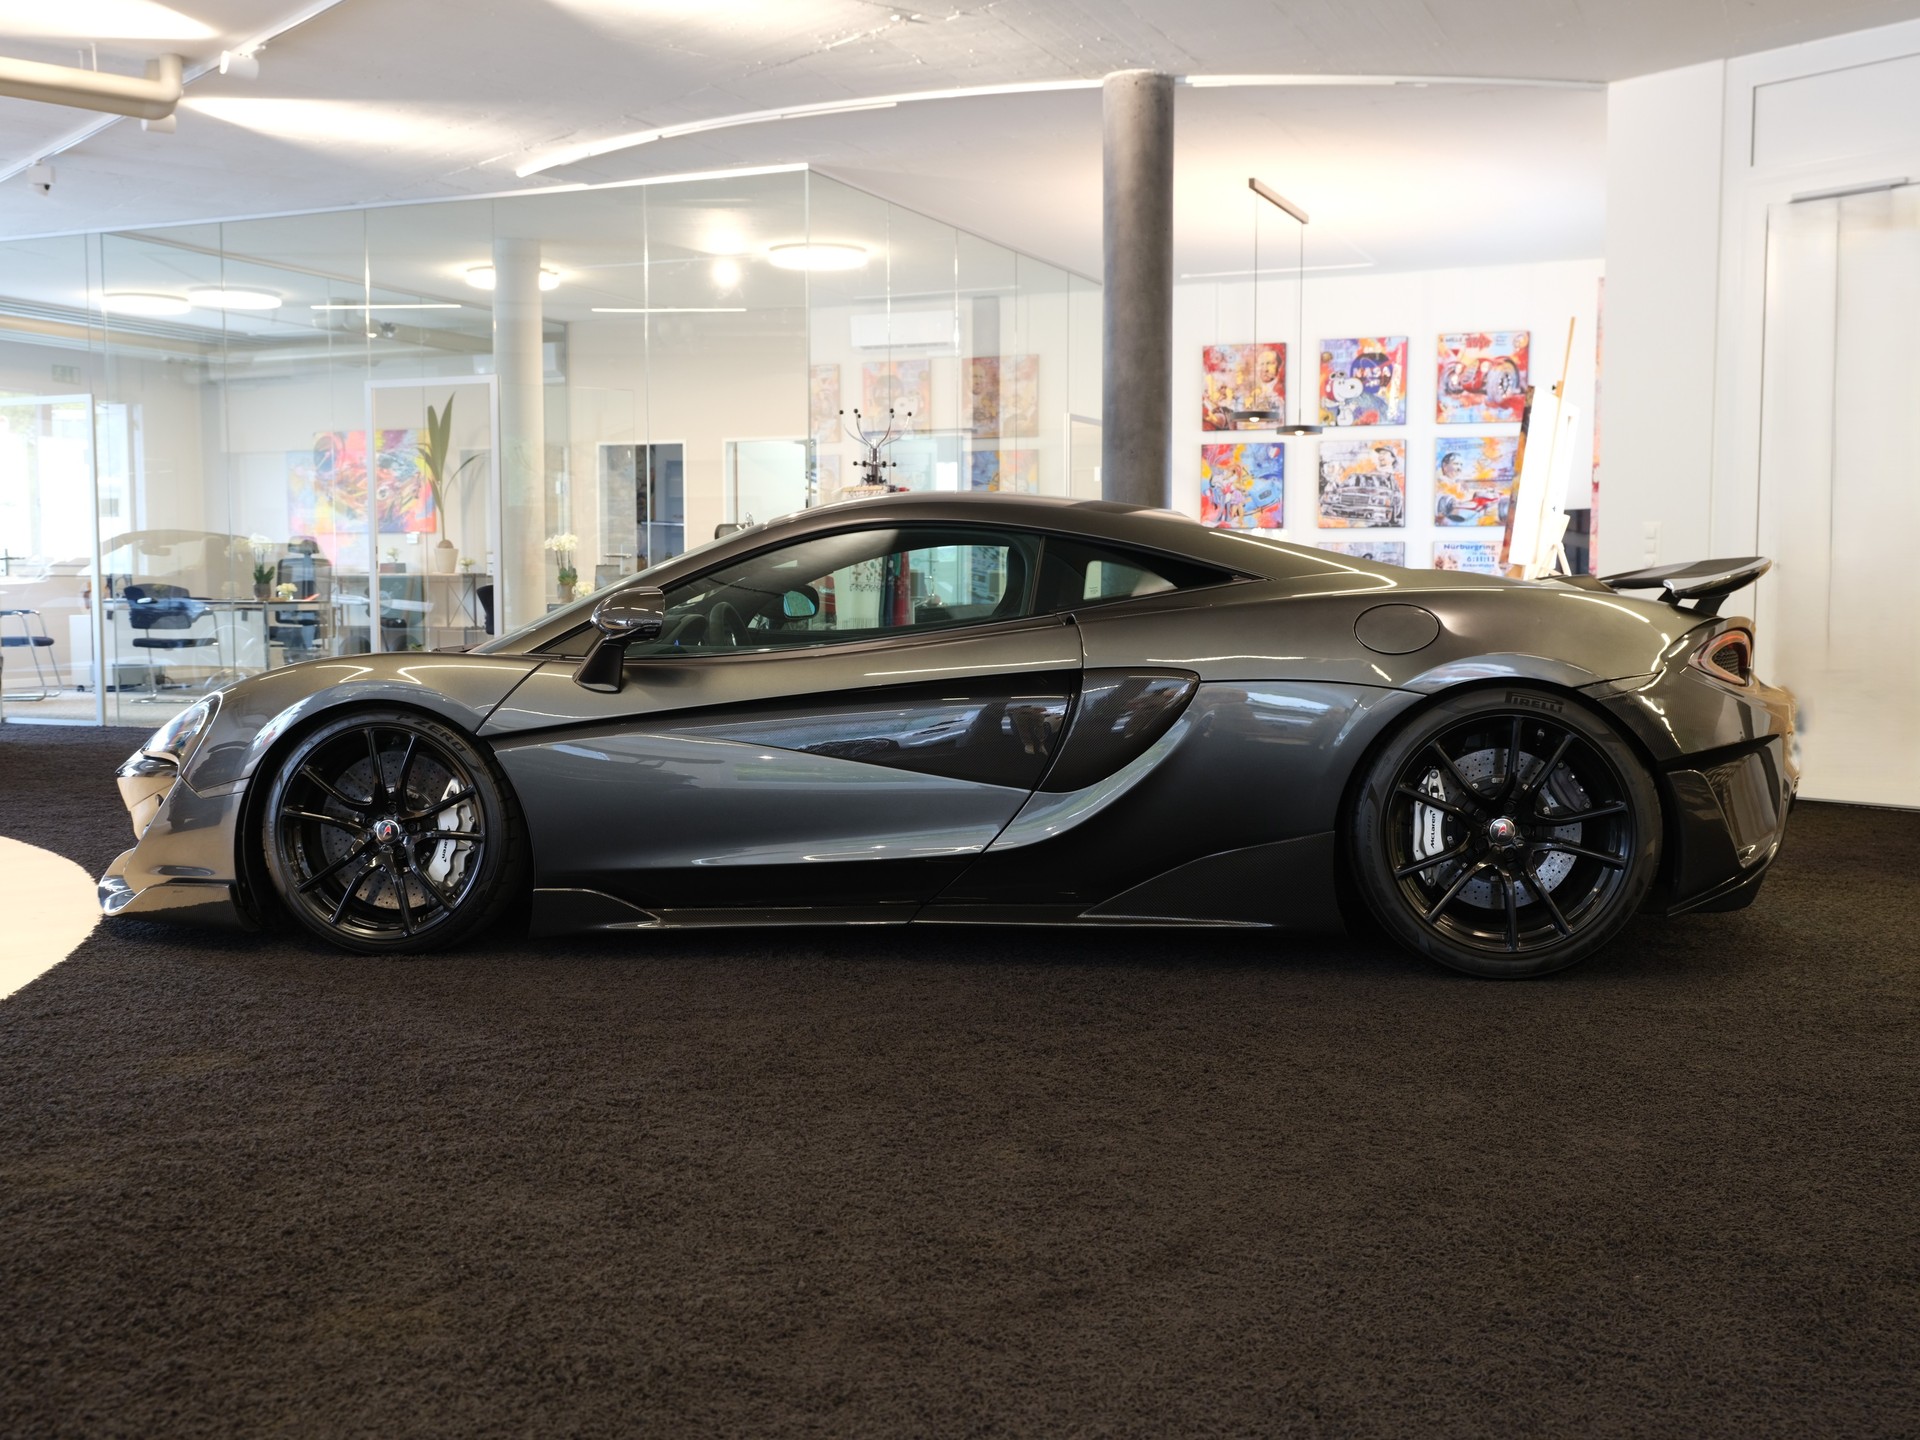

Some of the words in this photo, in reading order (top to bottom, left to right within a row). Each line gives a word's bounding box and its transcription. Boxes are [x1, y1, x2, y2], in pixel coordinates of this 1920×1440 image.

[1352, 366, 1391, 378] NASA
[1443, 543, 1496, 551] Nürburgring
[1504, 691, 1564, 714] PIRELLI
[414, 719, 467, 752] ZERO
